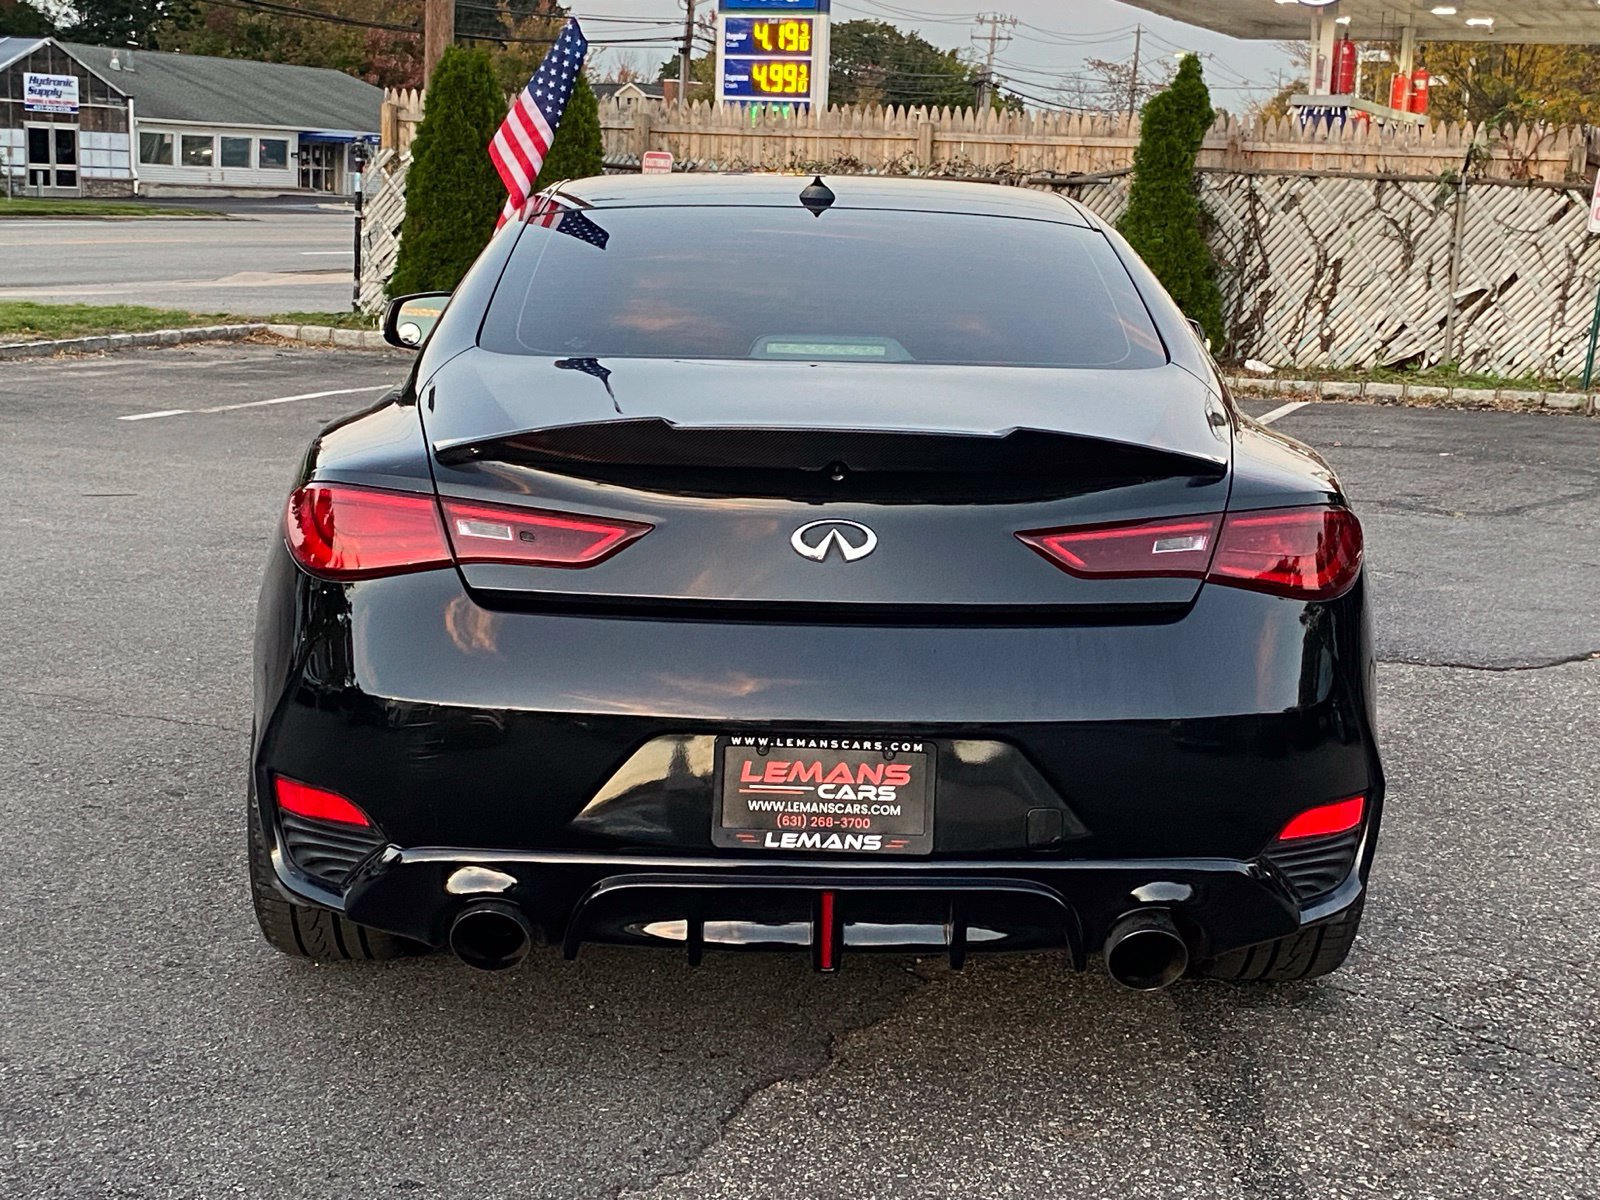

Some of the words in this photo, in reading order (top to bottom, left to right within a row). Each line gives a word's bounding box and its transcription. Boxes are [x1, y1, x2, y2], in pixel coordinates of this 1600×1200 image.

[29, 76, 74, 87] Hydronic
[28, 86, 63, 98] Supply
[731, 737, 924, 752] WWW.LEMANSCARS.COM
[740, 761, 912, 785] LEMANS
[818, 784, 897, 801] CARS
[748, 800, 901, 816] WWW.LEMANSCARS.COM
[776, 813, 807, 829] (631)
[811, 816, 871, 829] 268-3700
[764, 832, 883, 851] LEMANS
